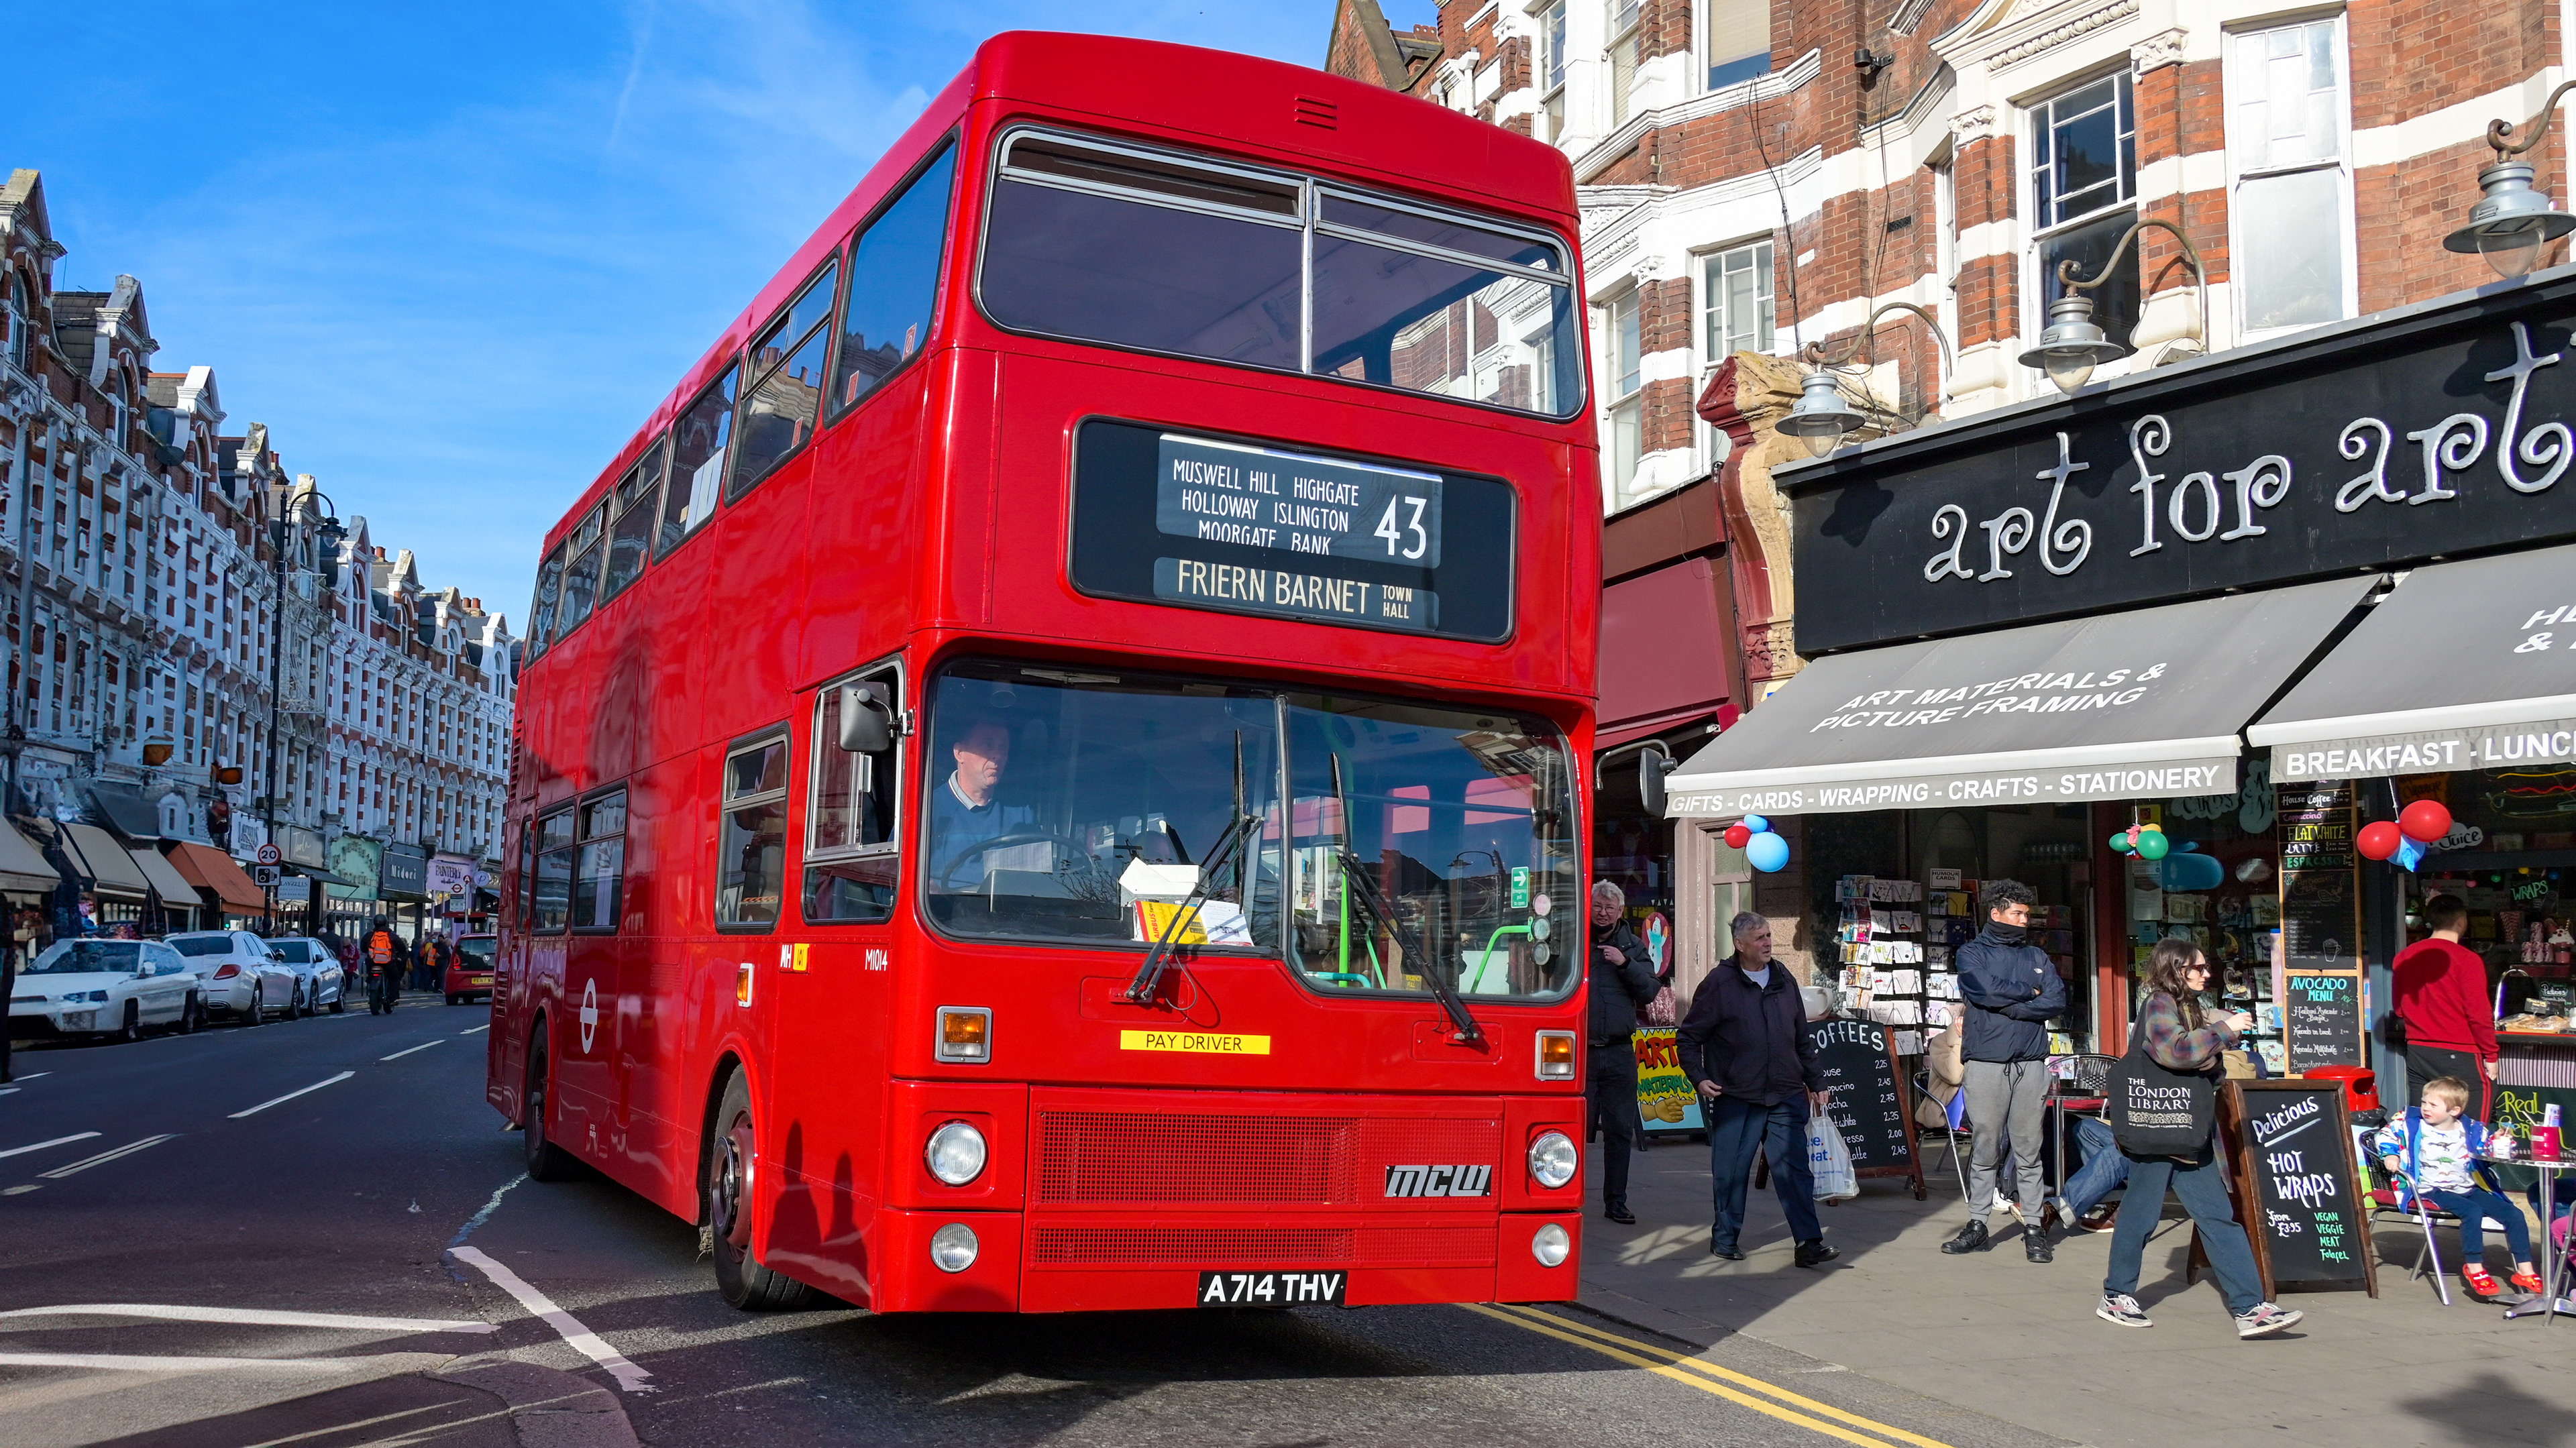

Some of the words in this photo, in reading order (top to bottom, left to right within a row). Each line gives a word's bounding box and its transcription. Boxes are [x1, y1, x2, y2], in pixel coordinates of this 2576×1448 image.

[1923, 431, 2092, 583] art
[2129, 413, 2292, 558] for
[2334, 321, 2576, 513] art
[1173, 459, 1240, 490] MUSWELL
[1249, 471, 1279, 495] HILL
[1293, 476, 1359, 507] HIGHGATE
[1182, 489, 1258, 520] HOLLOWAY
[1273, 502, 1349, 533] ISLINGTON
[1198, 520, 1276, 549] MOORGATE
[1291, 533, 1332, 556] BANK
[1373, 494, 1428, 560] 43
[1178, 559, 1265, 603] FRIERN
[1275, 571, 1371, 614] BARNET
[1381, 584, 1413, 602] TOWN
[1382, 602, 1410, 619] HALL
[1833, 689, 1915, 714] ART
[1911, 668, 2132, 706] MATERIALS
[2135, 662, 2168, 683] &
[1809, 706, 1963, 733] PICTURE
[1960, 685, 2148, 718] FRAMING
[2286, 740, 2460, 775] BREAKFAST
[1672, 795, 1723, 812] GIFTS
[1738, 790, 1803, 811] CARDS
[1819, 782, 1929, 806] WRAPPING
[1947, 776, 2038, 800] CRAFTS
[2059, 765, 2220, 795] STATIONERY
[2282, 795, 2305, 805] House
[2307, 794, 2331, 807] Coffee
[2288, 825, 2314, 841] FLAT
[2314, 825, 2346, 840] WHITE
[2438, 830, 2481, 849] Juice
[261, 850, 276, 859] 20
[2285, 842, 2320, 854] LATTE
[390, 865, 417, 881] Midori
[2287, 856, 2341, 868] ESPRESSO
[2510, 880, 2548, 901] WRAPS
[1150, 912, 1161, 939] AIRBUS
[780, 944, 792, 968] MH
[865, 948, 888, 971] M1014
[2291, 977, 2348, 991] AVOCADO
[2307, 990, 2334, 1001] MENU
[1145, 1034, 1179, 1051] PAY
[1183, 1034, 1242, 1052] DRIVER
[1635, 1037, 1679, 1070] ART
[1637, 1074, 1694, 1097] MATERIALS
[1827, 1082, 1855, 1096] ppucino
[2127, 1077, 2145, 1086] THE
[2128, 1085, 2191, 1099] LONDON
[2128, 1097, 2191, 1110] LIBRARY
[2496, 1091, 2545, 1121] Real
[2251, 1096, 2319, 1143] Delicious
[1843, 1134, 1864, 1144] resso
[2267, 1150, 2302, 1174] HOT
[1385, 1165, 1492, 1197] MCW
[2273, 1173, 2335, 1209] WRAPS
[2314, 1212, 2339, 1221] VEGAN
[2320, 1235, 2340, 1247] MEAT
[1203, 1274, 1276, 1302] A714
[1281, 1274, 1340, 1301] THV
